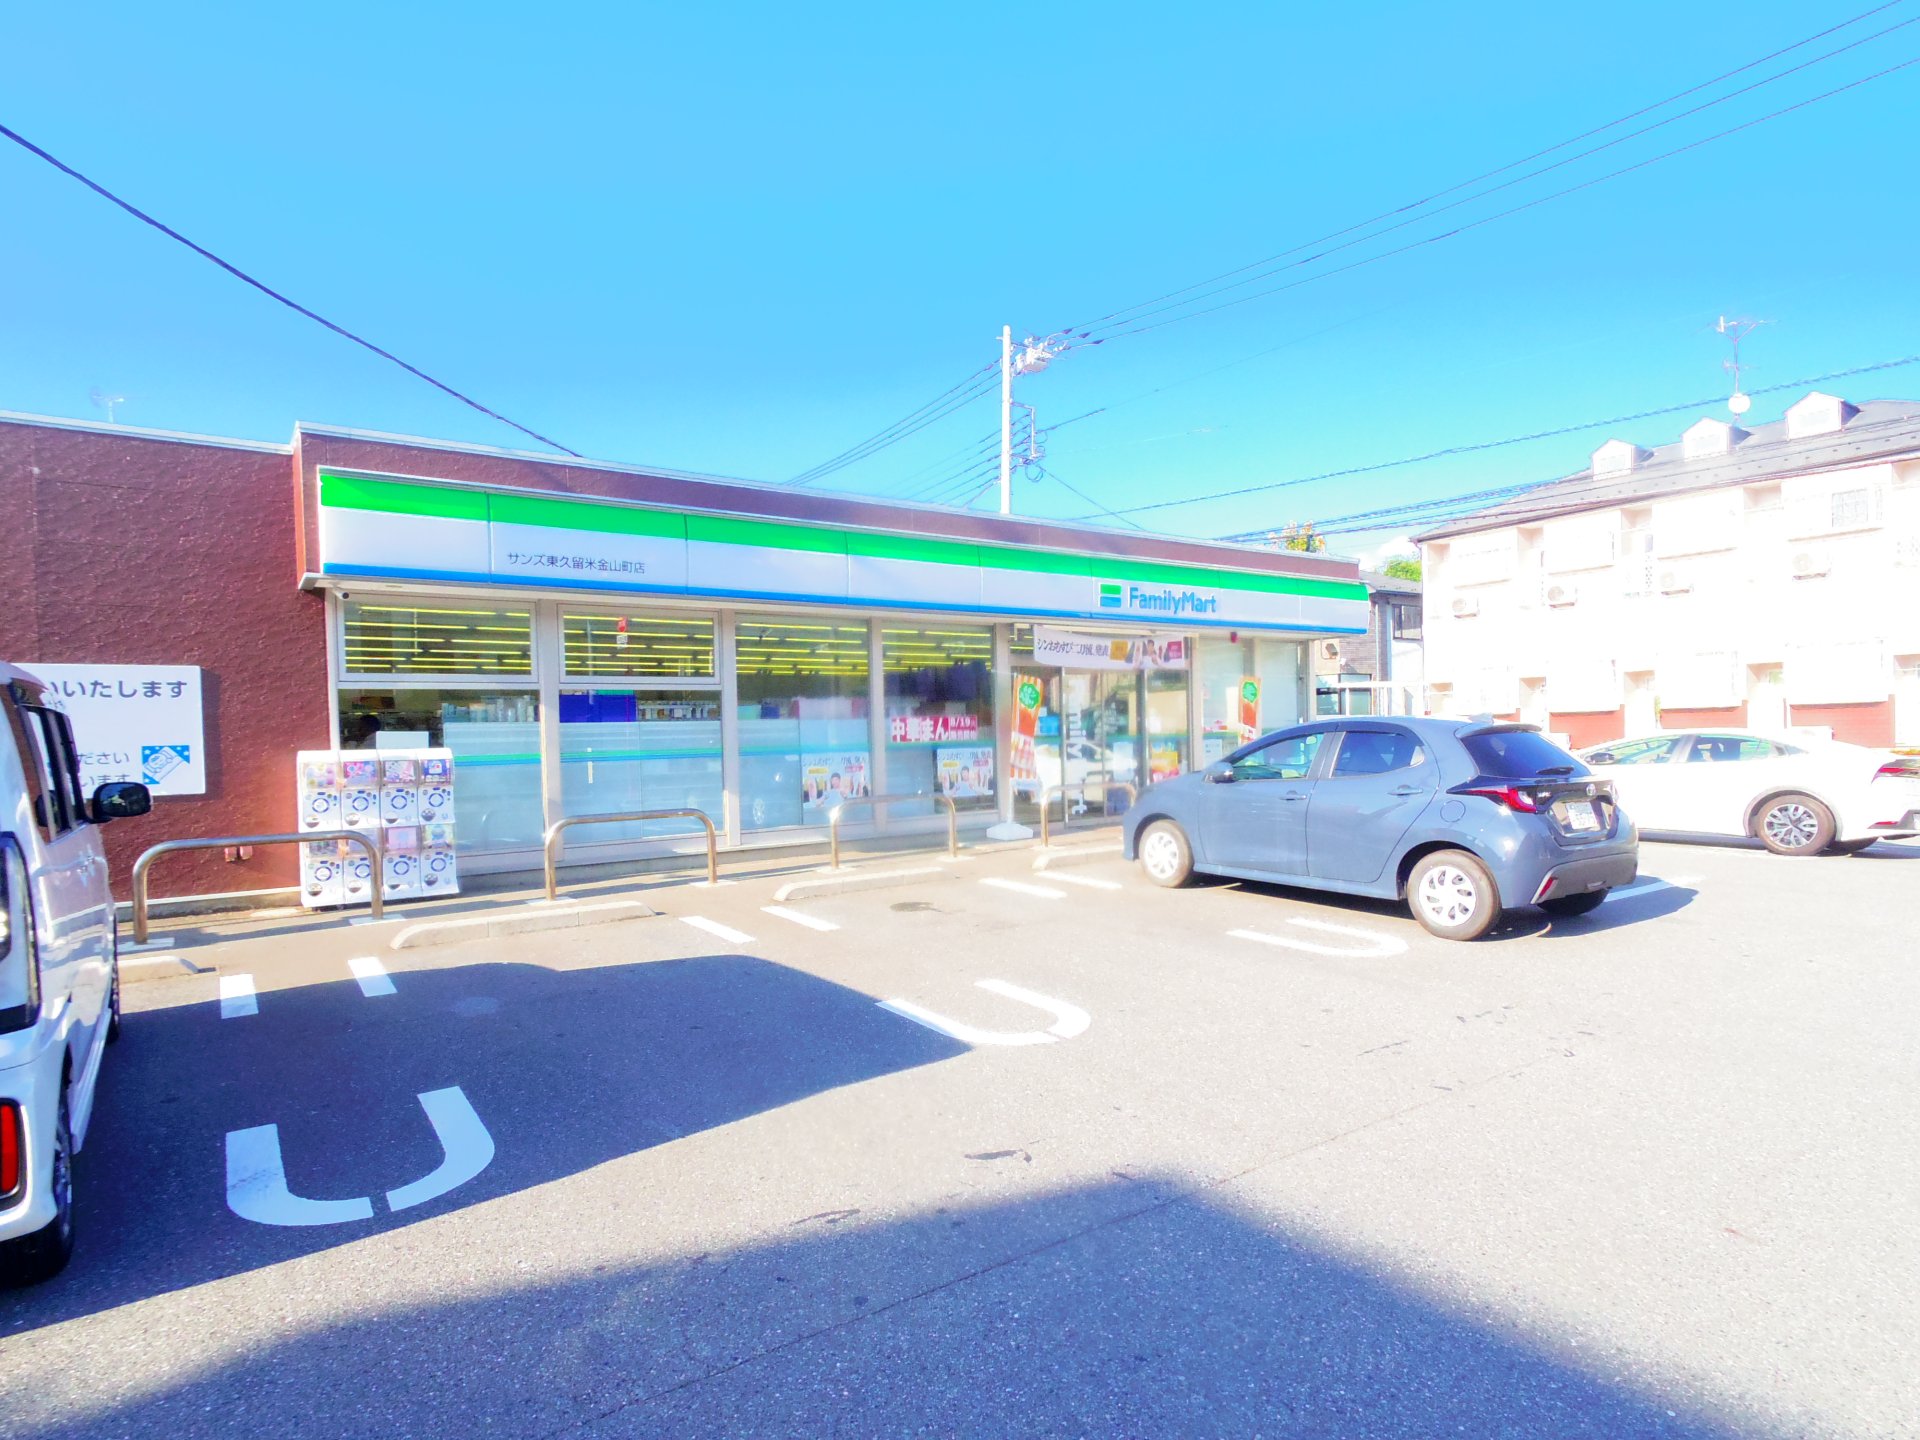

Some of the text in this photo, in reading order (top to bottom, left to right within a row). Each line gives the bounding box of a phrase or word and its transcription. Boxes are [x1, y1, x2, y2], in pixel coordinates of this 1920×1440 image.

[508, 552, 646, 574] サンズ東久留米金山町店
[1129, 586, 1217, 614] FamilyMart
